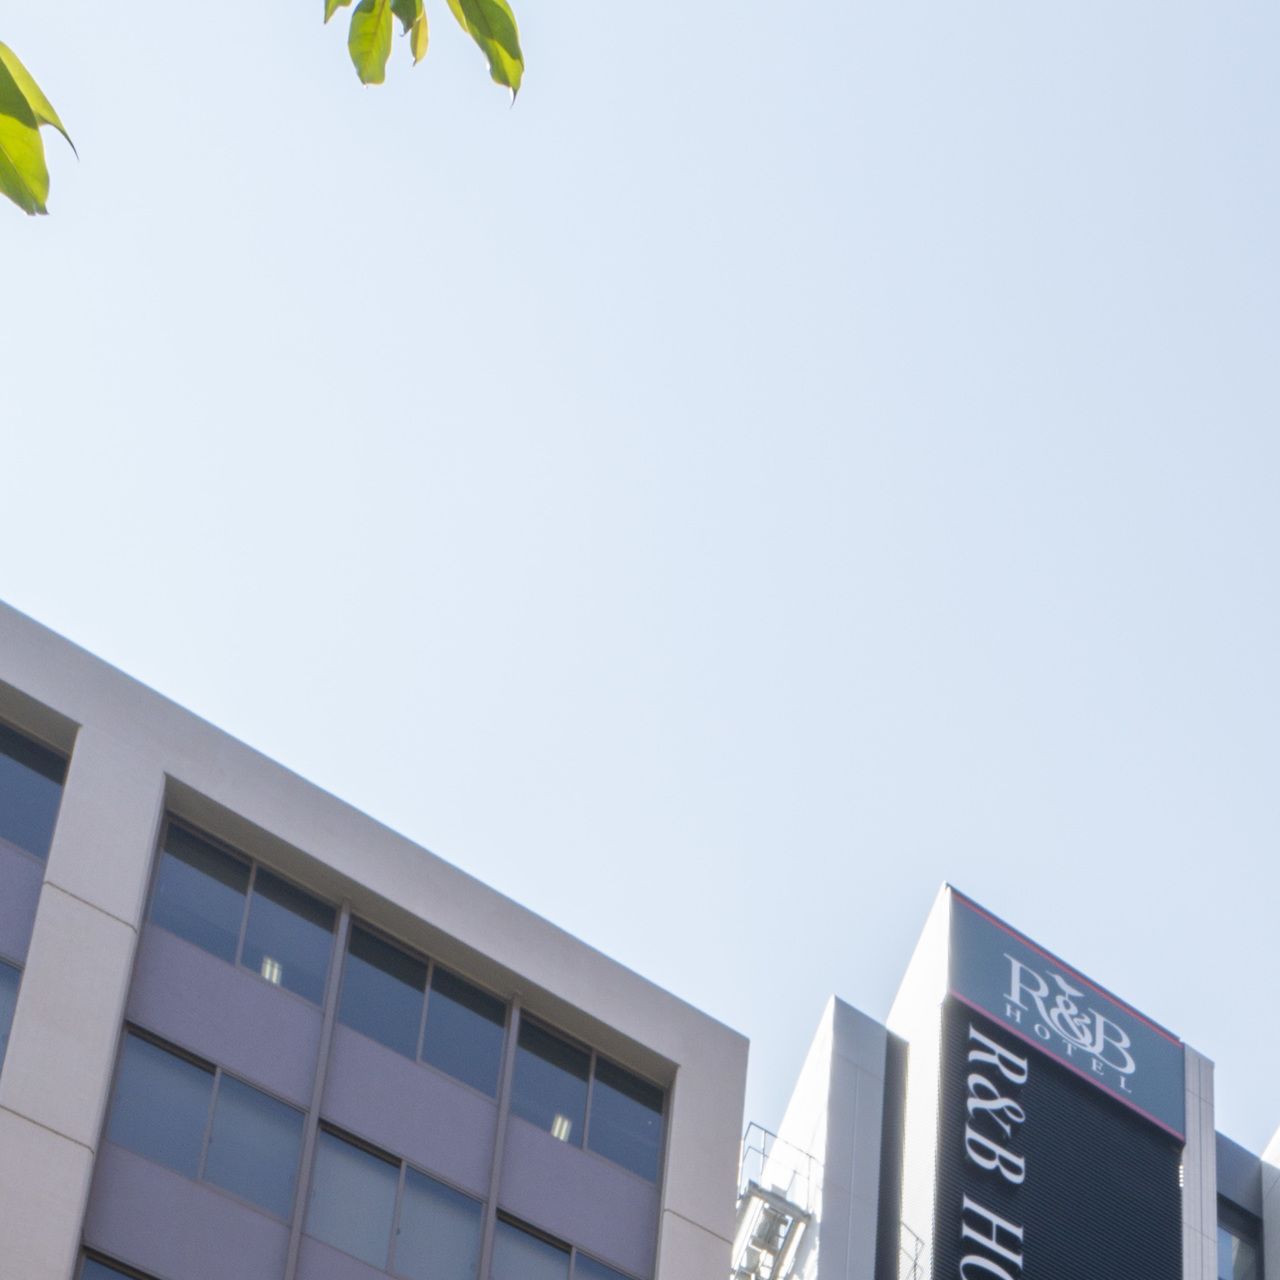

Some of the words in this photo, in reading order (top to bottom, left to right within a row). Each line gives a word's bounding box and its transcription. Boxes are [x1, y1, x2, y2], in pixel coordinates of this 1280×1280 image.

[1003, 952, 1135, 1075] R&B
[1005, 1004, 1132, 1093] HOTEL
[965, 1022, 1028, 1185] R&B
